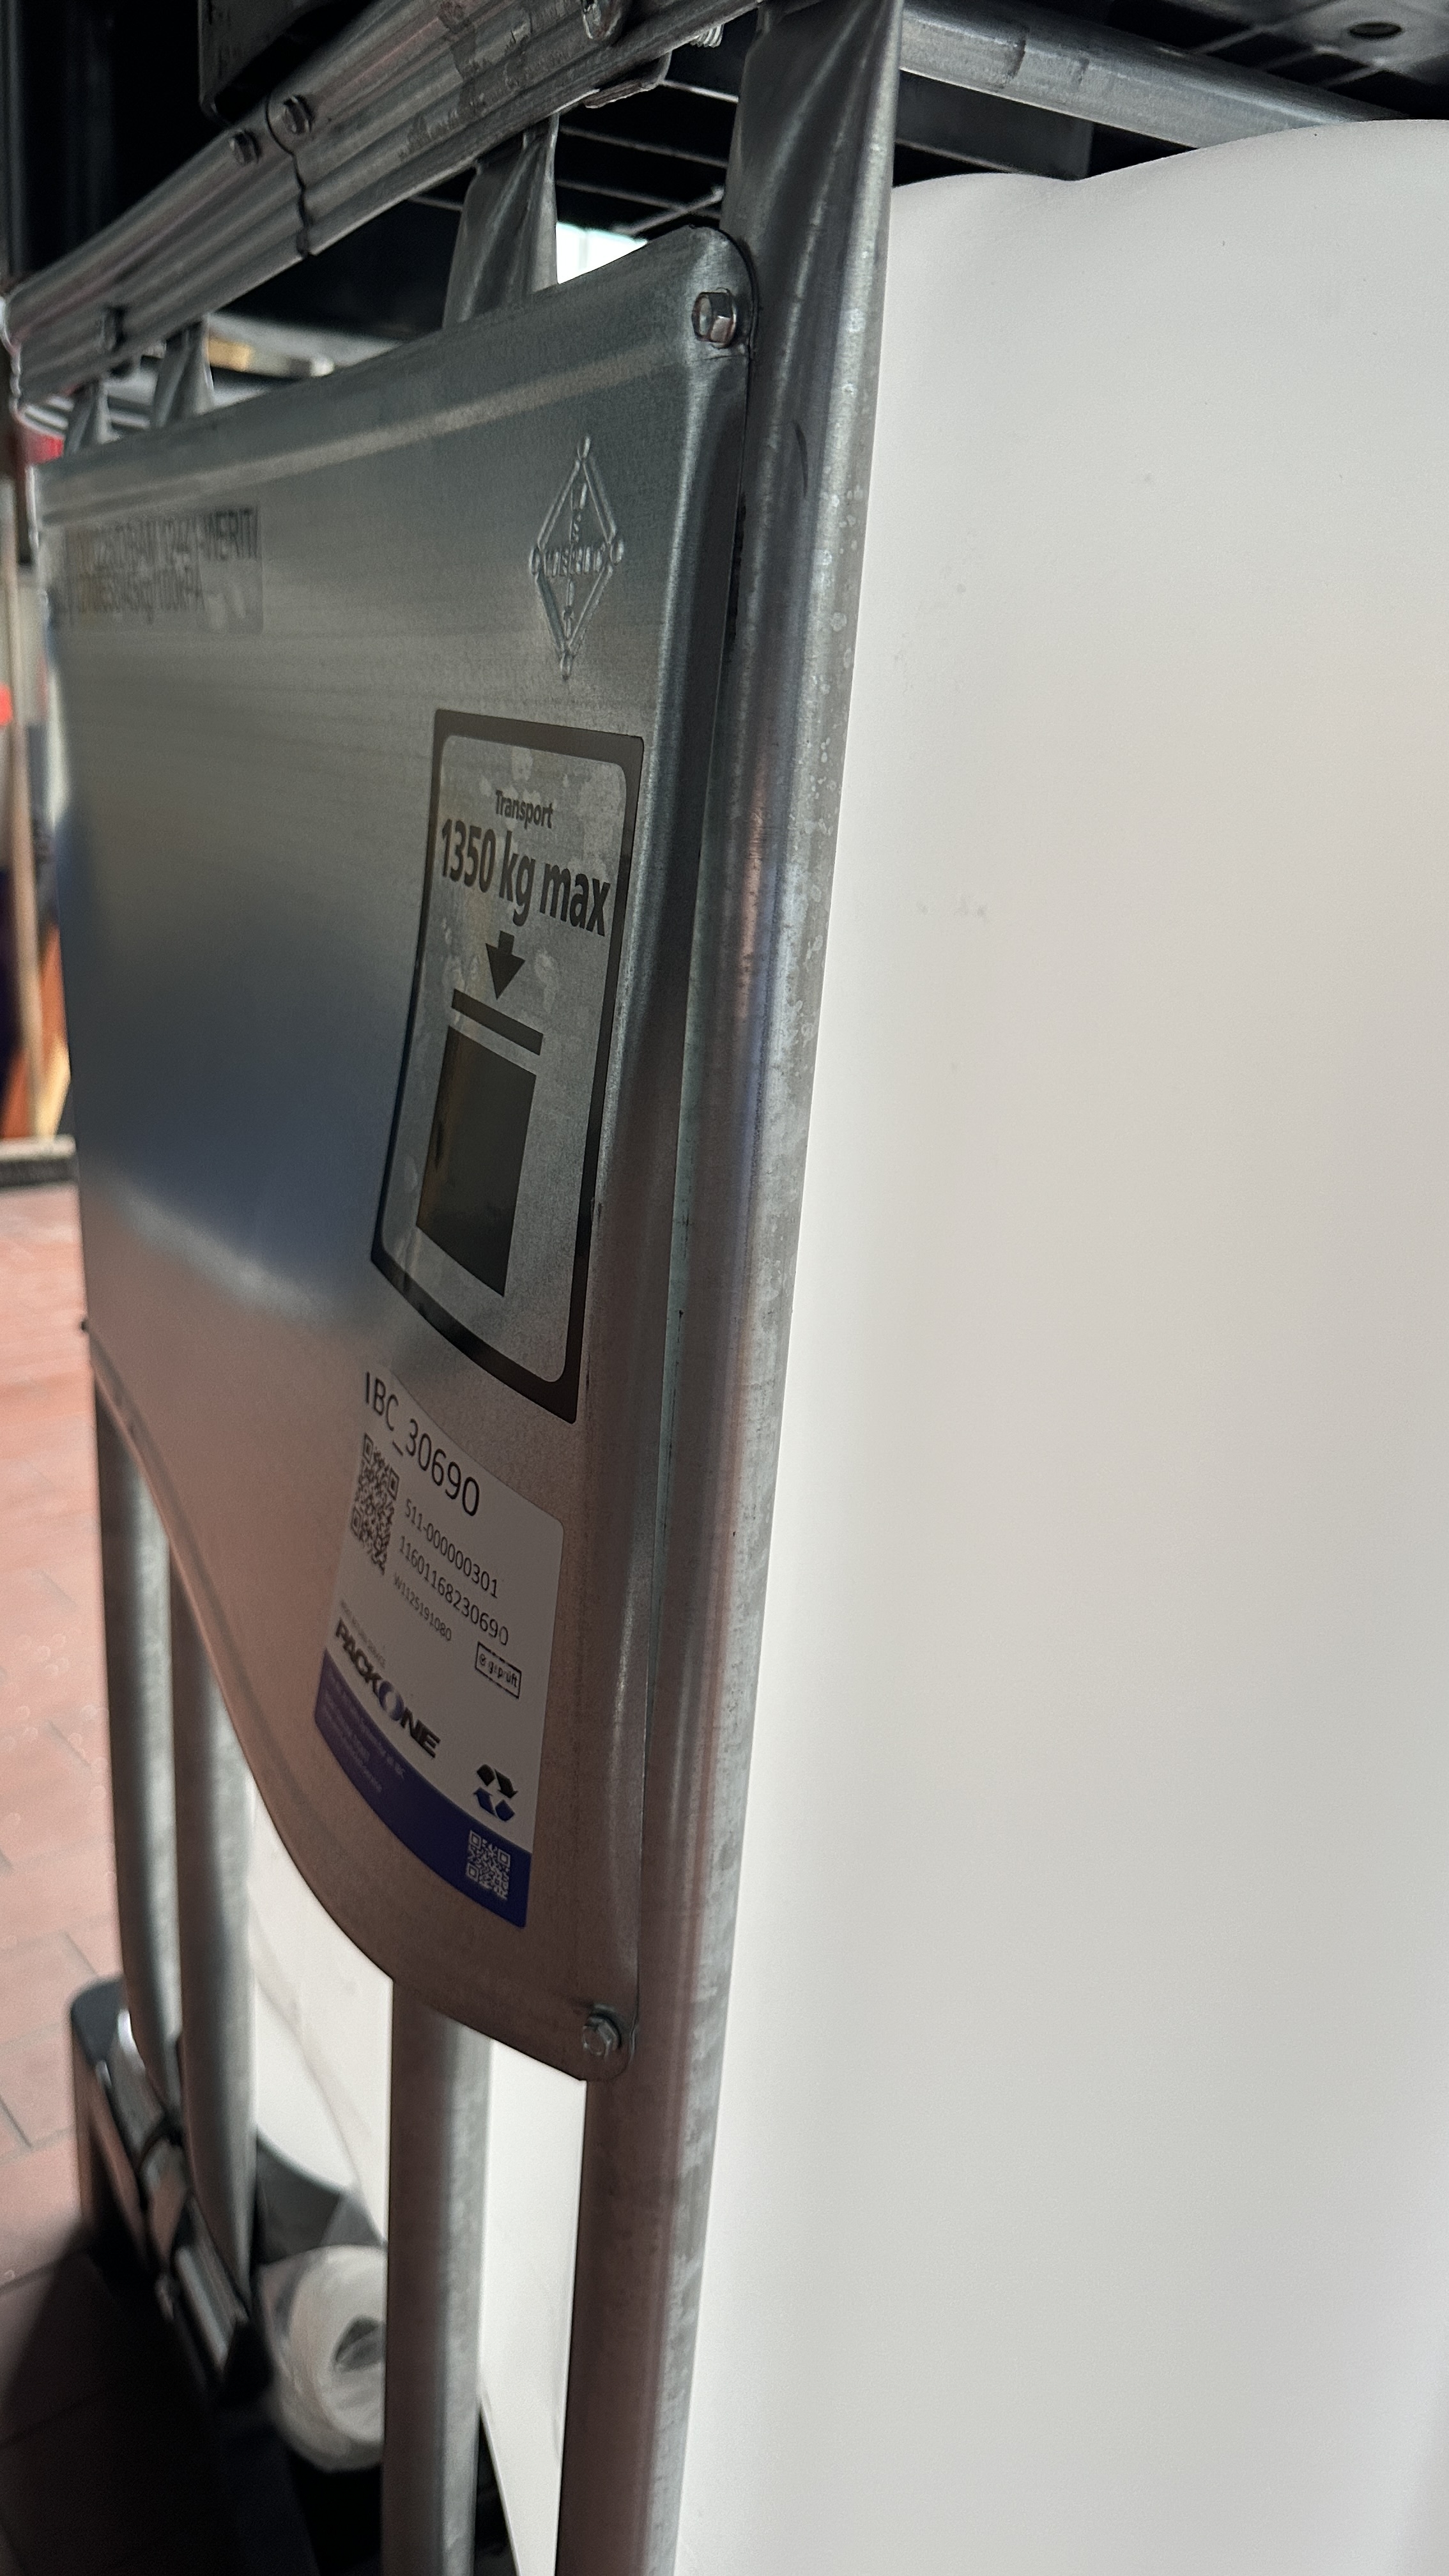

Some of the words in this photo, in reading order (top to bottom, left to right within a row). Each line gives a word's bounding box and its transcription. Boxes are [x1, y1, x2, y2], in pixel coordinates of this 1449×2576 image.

[495, 790, 554, 829] Transport
[441, 818, 496, 893] 1350
[499, 831, 536, 926] kg
[539, 862, 611, 937] max
[364, 1371, 480, 1517] IBC_30690
[399, 1536, 509, 1646] 11601168230690
[405, 1499, 498, 1598] 511-000000301
[394, 1572, 452, 1641] W1125191080
[335, 1618, 441, 1758] PACKONE
